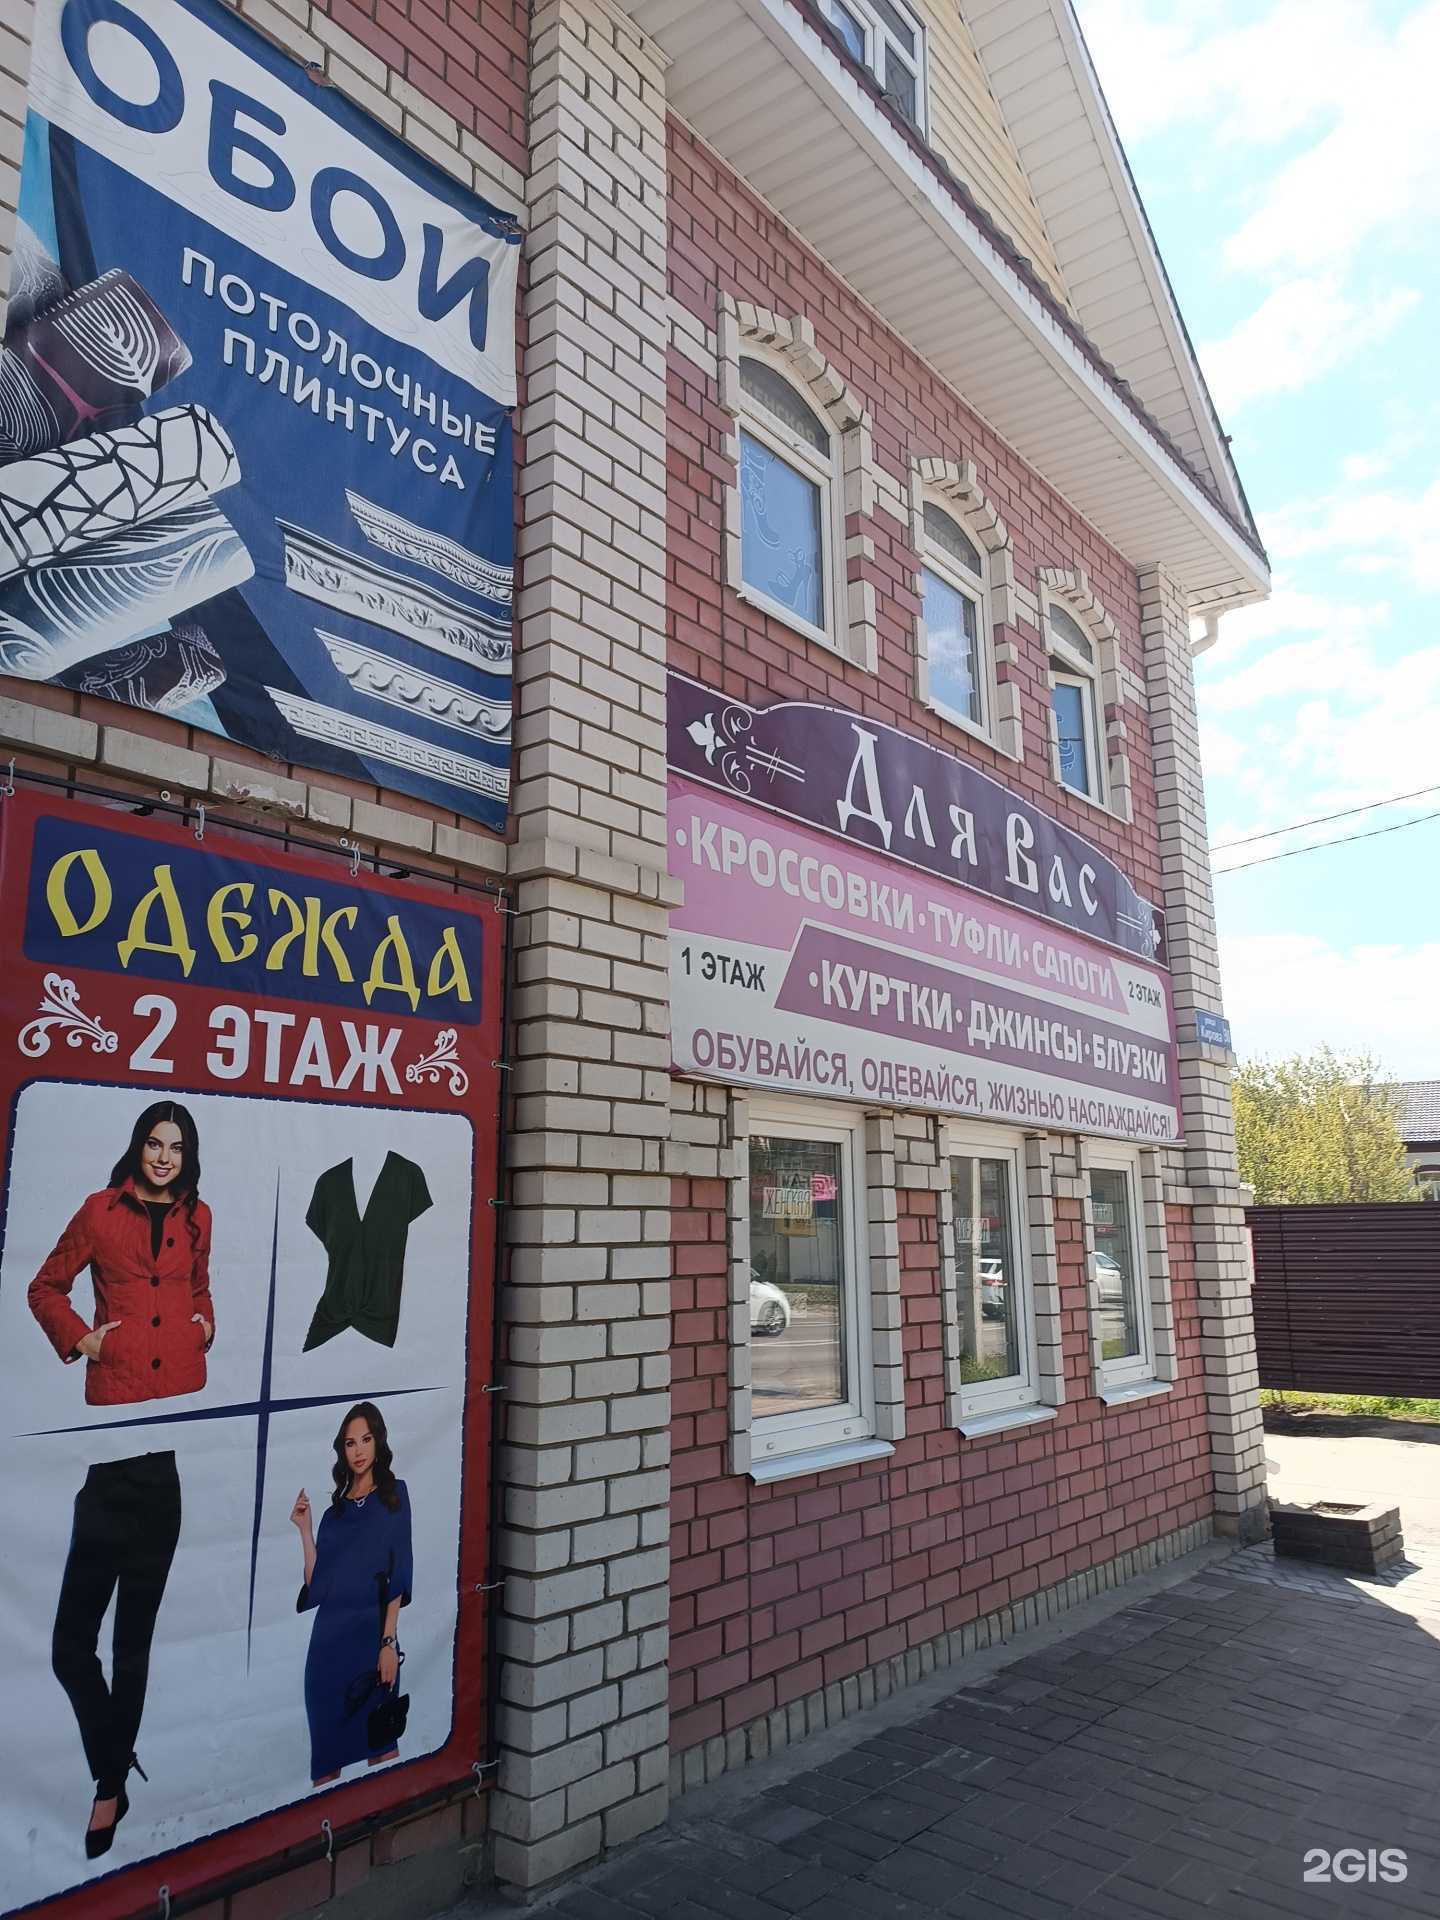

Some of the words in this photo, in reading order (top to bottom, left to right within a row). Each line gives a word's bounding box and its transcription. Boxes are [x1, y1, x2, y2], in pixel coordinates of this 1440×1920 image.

[61, 0, 490, 352] ОБОИ
[182, 247, 497, 456] ПОТОЛОЧНЫЕ
[223, 329, 465, 490] ПЛИНТУСА
[47, 849, 473, 1012] ОДЕЖДА
[681, 947, 691, 975] 1
[701, 952, 766, 992] ЭТАЖ
[691, 816, 914, 934] КРОССОВКИ
[928, 901, 1022, 969] ТУФЛИ
[1033, 941, 1114, 1000] САПОГИ
[129, 995, 178, 1073] 2
[206, 1004, 403, 1095] ЭТАЖ
[821, 960, 953, 1033] КУРТКИ
[968, 1000, 1083, 1064] ДЖИНСЫ
[1093, 1034, 1167, 1085] БЛУЗКИ
[1128, 981, 1135, 998] 2
[1136, 984, 1162, 1009] ЭТАЖ
[692, 1028, 854, 1093] ОБУВАЙСЯ,
[862, 1058, 983, 1113] ОДЕВАЙСЯ,
[988, 1080, 1064, 1121] ЖИЗНЬЮ
[1069, 1102, 1172, 1138] НАСЛАЖДАЙСЯ!
